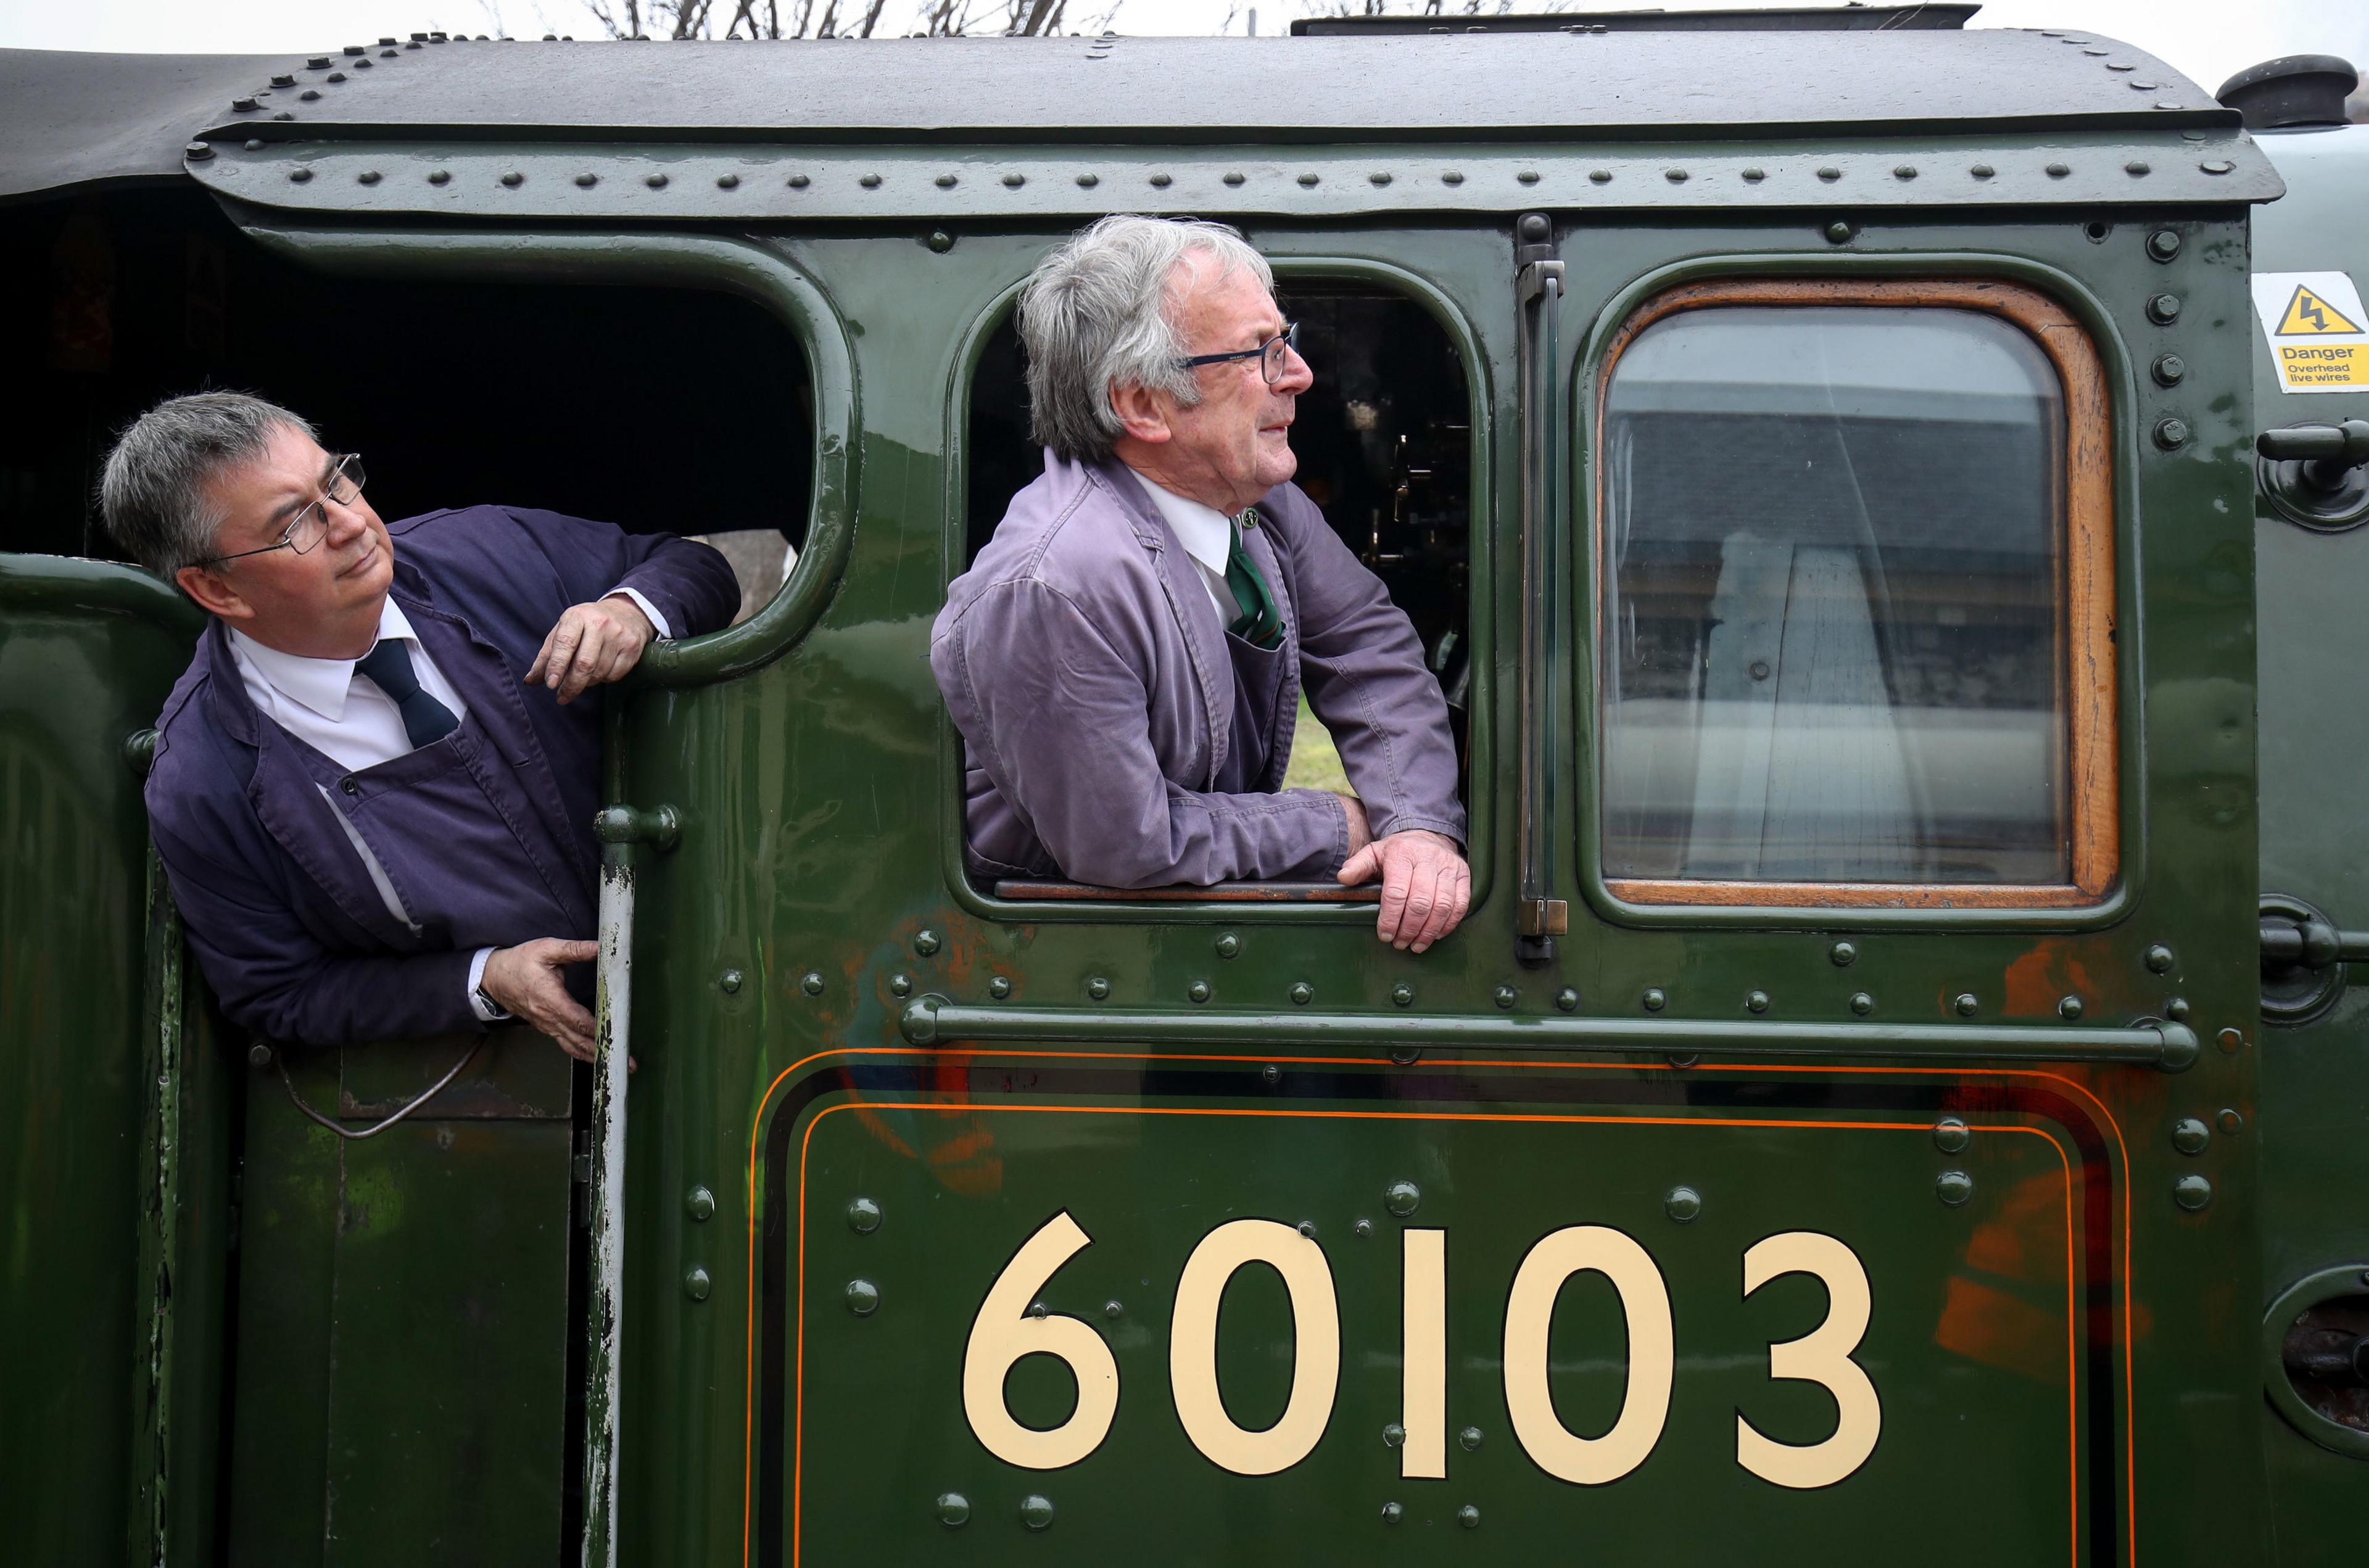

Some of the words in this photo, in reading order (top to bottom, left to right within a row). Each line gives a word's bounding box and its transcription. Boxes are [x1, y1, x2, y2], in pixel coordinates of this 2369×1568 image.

[2283, 348, 2354, 360] Danger
[2288, 363, 2350, 373] Overhead
[2290, 374, 2313, 382] live
[2315, 373, 2350, 381] wires
[962, 1206, 1883, 1490] 60103
